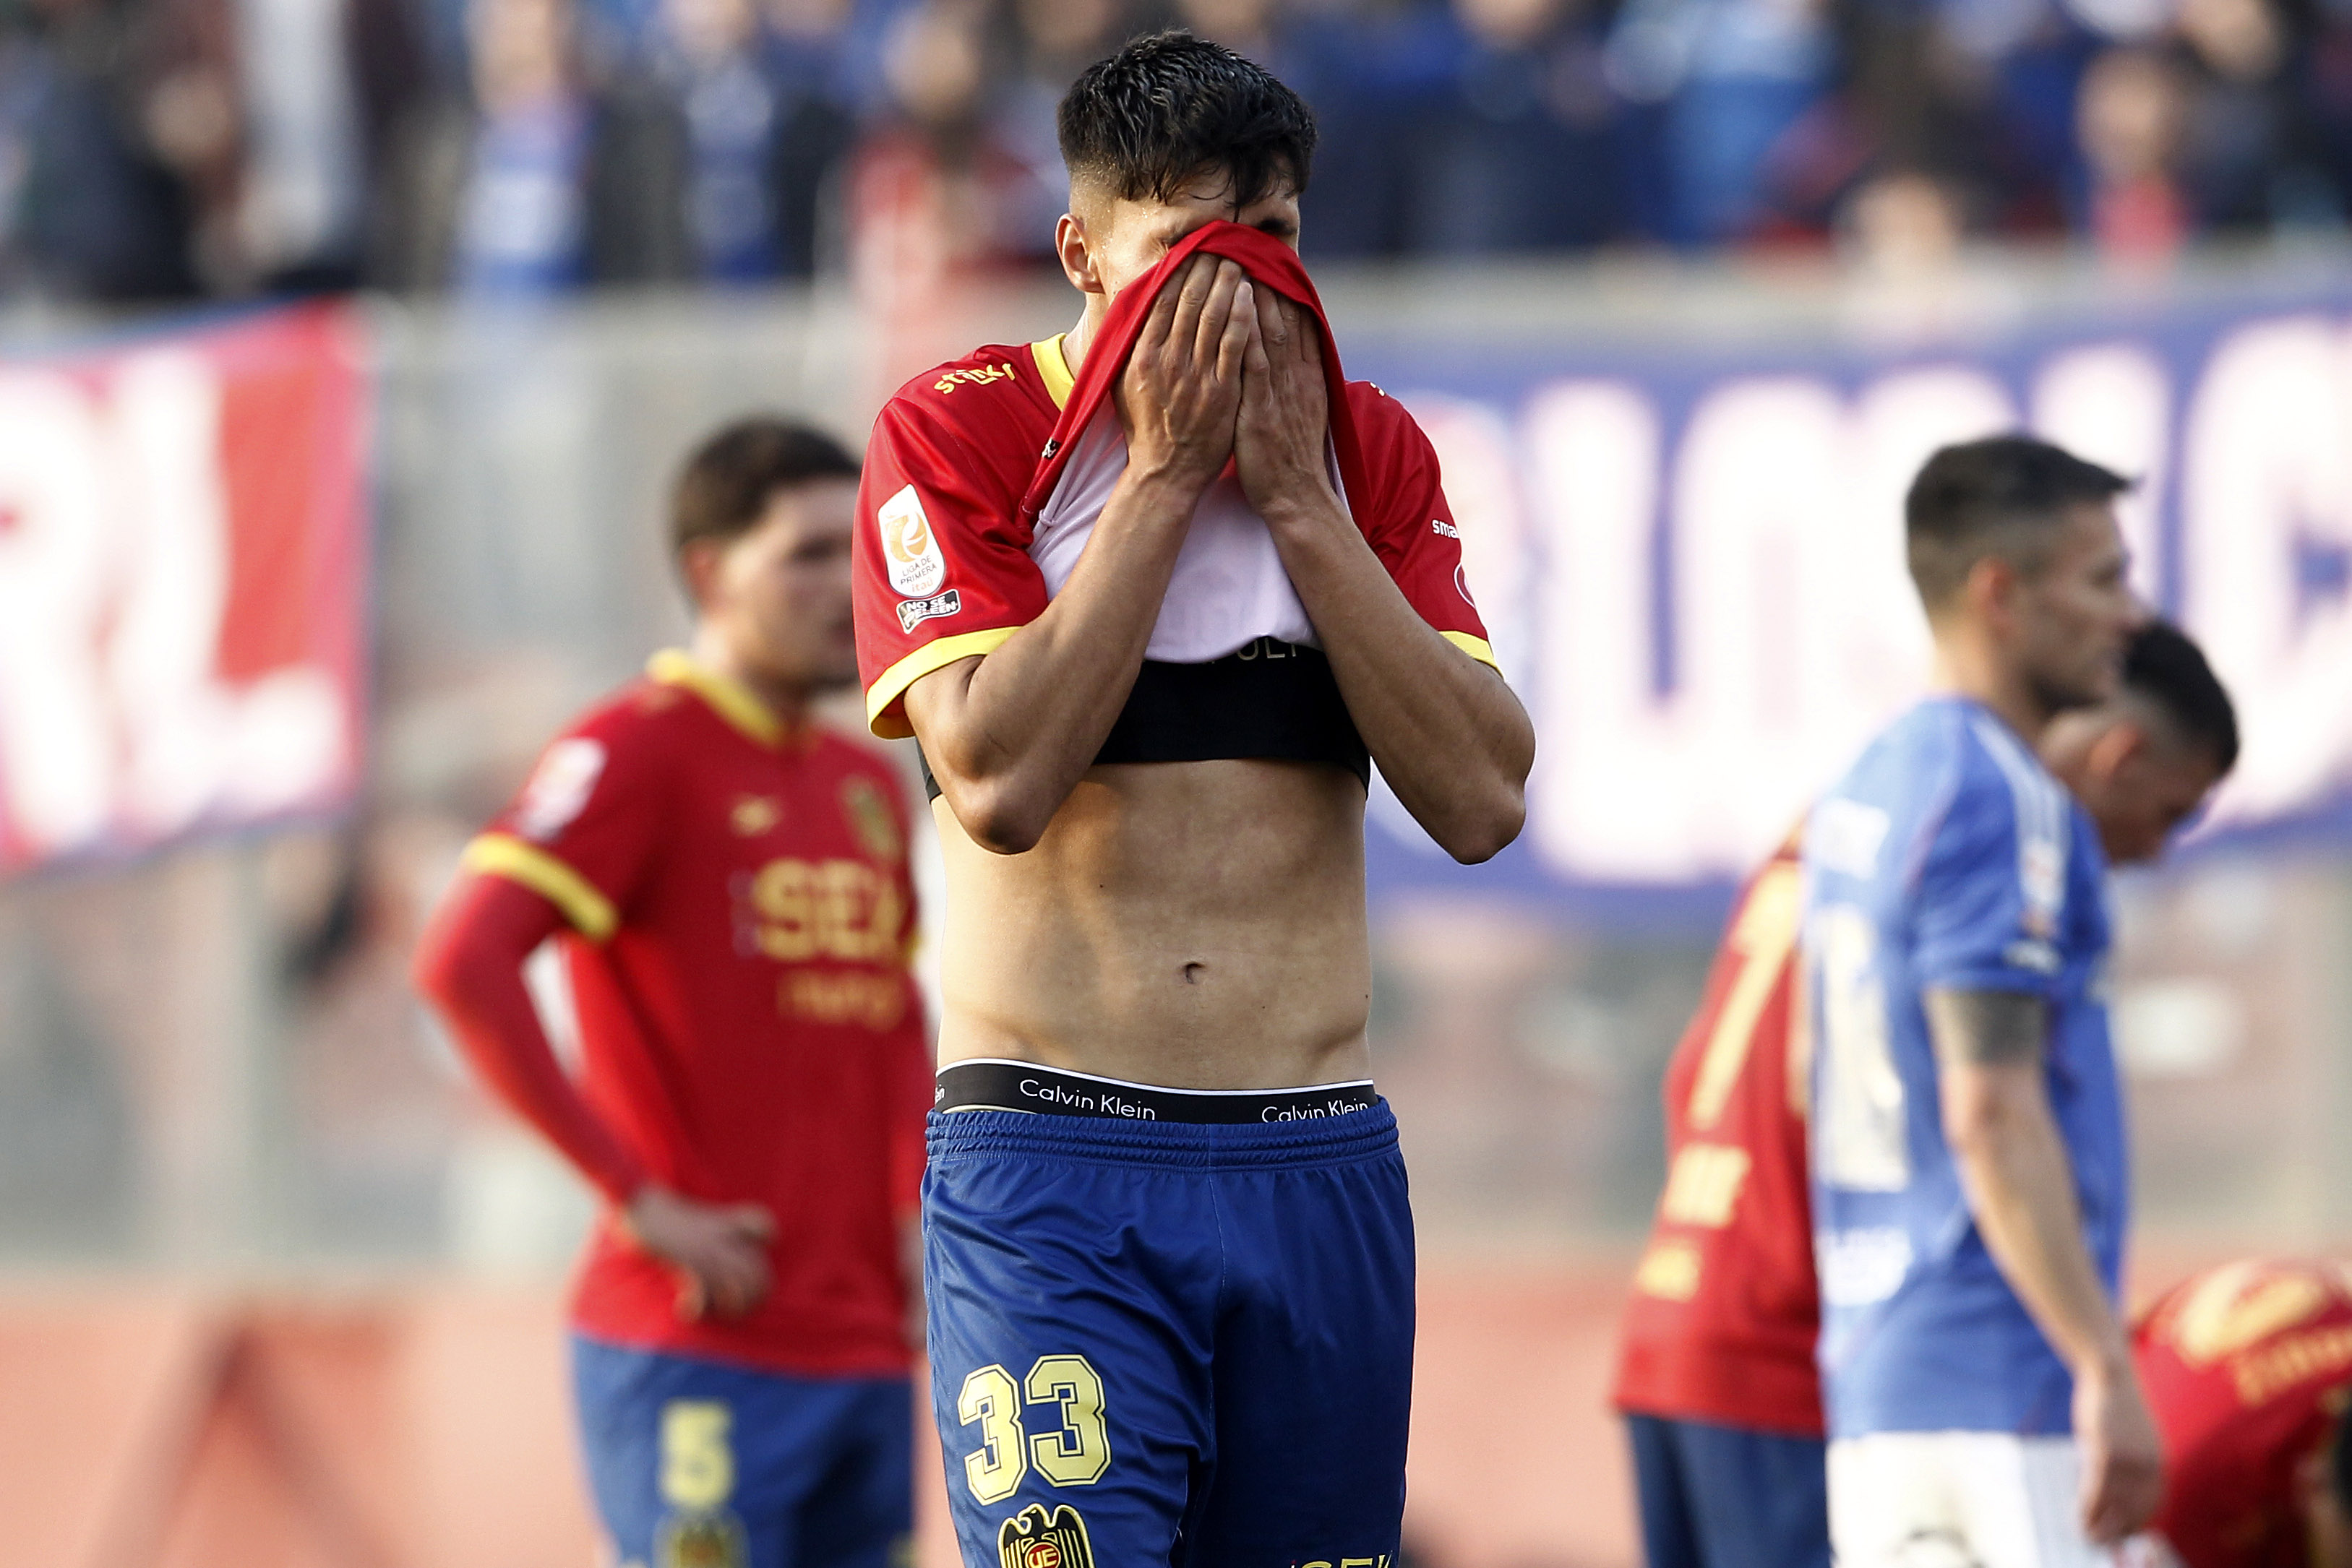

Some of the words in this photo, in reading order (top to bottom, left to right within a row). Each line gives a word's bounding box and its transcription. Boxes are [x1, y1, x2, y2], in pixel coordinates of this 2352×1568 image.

[901, 564, 937, 585] PRIMERA
[902, 563, 920, 577] LIGA
[922, 556, 932, 566] DE
[906, 600, 928, 613] NO
[930, 596, 946, 608] SE
[1019, 1079, 1094, 1111] Calvin
[1100, 1094, 1156, 1121] Klein
[1261, 1103, 1326, 1124] Calvin
[1327, 1098, 1369, 1117] Klein
[957, 1353, 1112, 1507] 33
